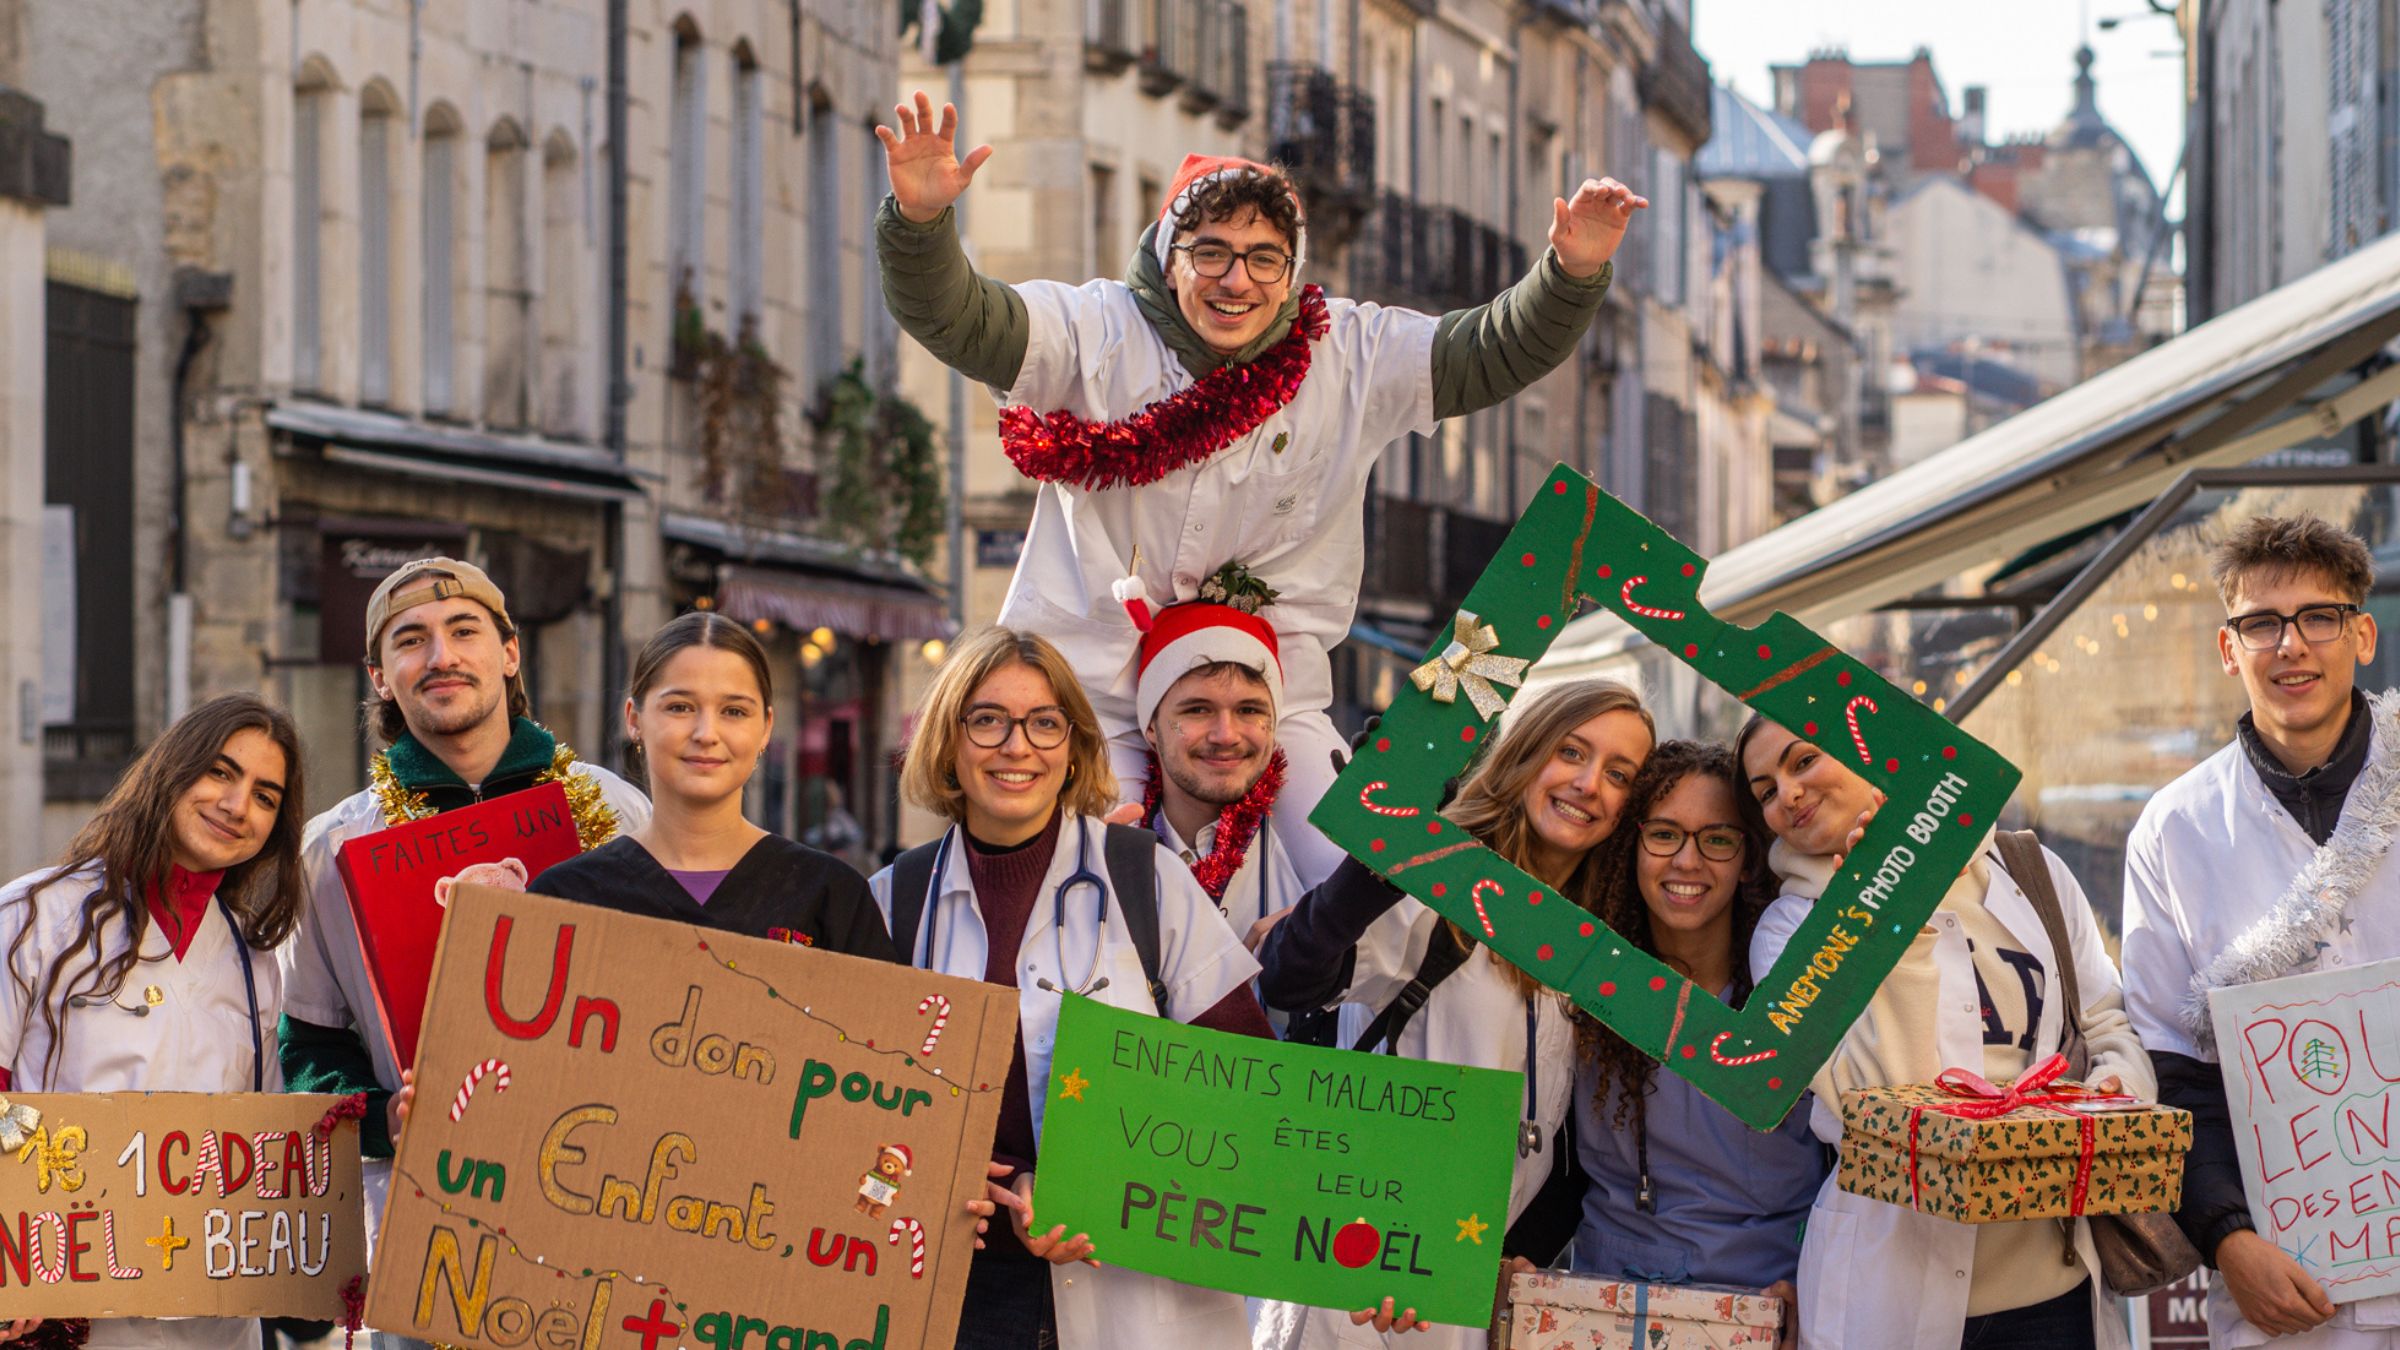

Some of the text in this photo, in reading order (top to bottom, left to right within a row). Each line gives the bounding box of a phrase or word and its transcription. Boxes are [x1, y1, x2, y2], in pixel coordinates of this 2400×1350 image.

[369, 802, 562, 875] FAITES UN
[1858, 845, 1915, 910] PHOTO
[1906, 771, 1968, 845] BOOTH
[484, 914, 932, 1139] Un don pour
[1113, 1030, 1457, 1121] ENFANTS MALADES
[118, 1130, 146, 1197] 1
[1120, 1107, 1351, 1170] VOUS ÊTES
[437, 1150, 506, 1202] un
[806, 1227, 878, 1276] un
[1120, 1179, 1433, 1276] PÈRE NOËL
[1317, 1173, 1403, 1203] LEUR
[0, 1200, 331, 1286] NOËL + BEAU
[413, 1224, 612, 1350] Noël
